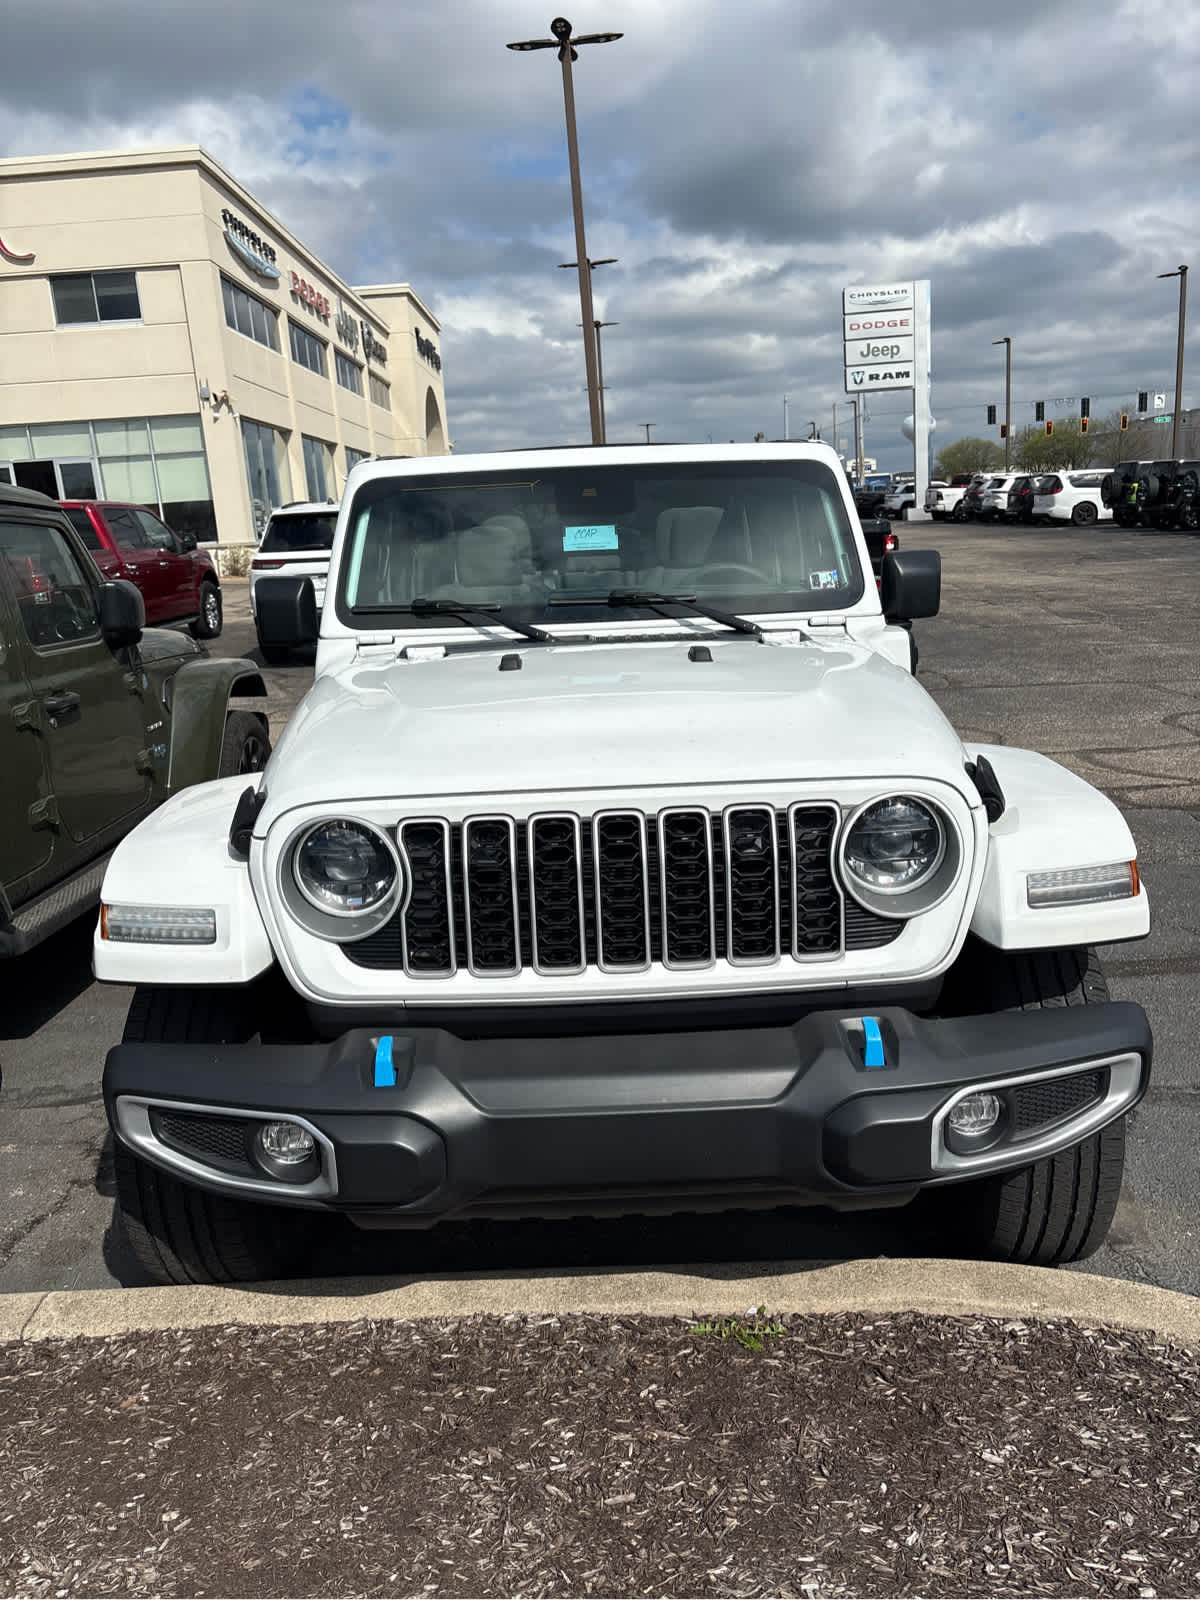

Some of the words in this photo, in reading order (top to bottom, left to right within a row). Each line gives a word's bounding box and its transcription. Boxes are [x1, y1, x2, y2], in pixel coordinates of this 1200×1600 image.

[289, 270, 331, 318] DODGE
[849, 288, 908, 299] CHRYSLER
[849, 318, 910, 331] DODGE
[860, 342, 900, 359] Jeep
[868, 370, 910, 381] RAM
